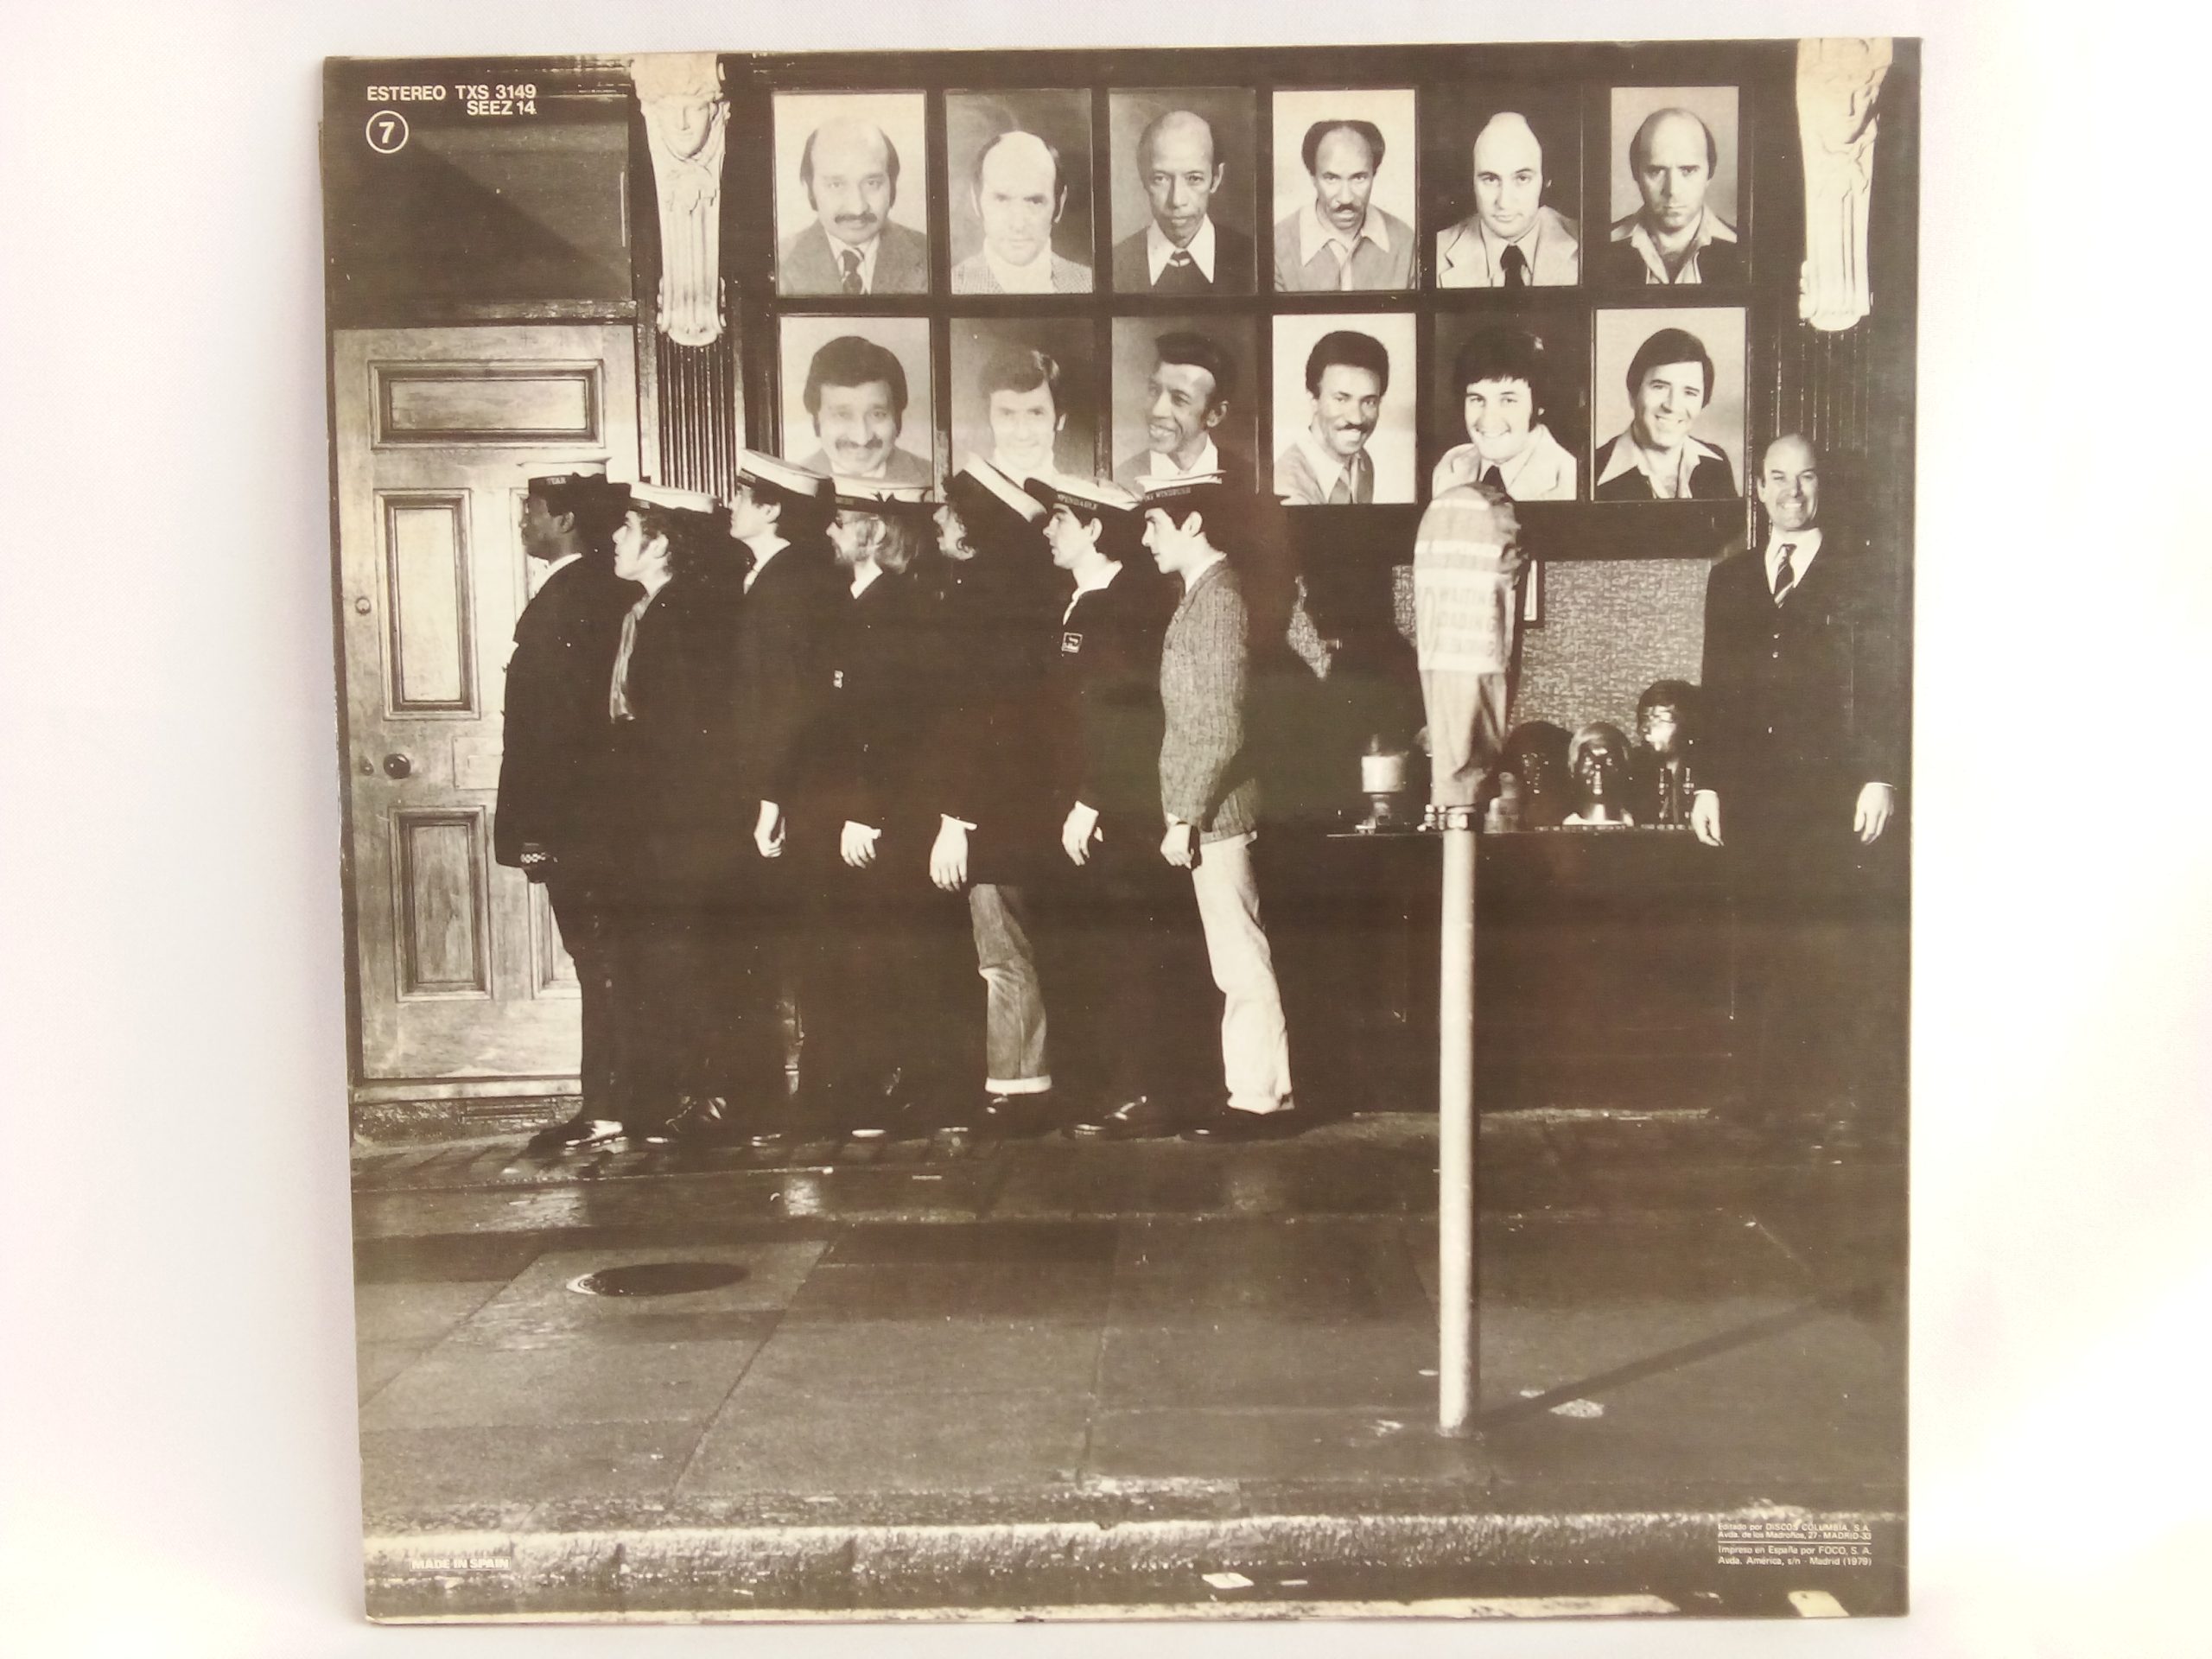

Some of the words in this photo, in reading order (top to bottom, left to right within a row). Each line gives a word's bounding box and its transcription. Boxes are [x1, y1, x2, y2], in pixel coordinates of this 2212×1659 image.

[366, 85, 446, 101] ESTEREO
[454, 85, 490, 100] TXS
[495, 83, 537, 100] 3149
[467, 100, 513, 115] SEEZ
[378, 121, 396, 143] 7
[1718, 1522, 1747, 1531] Editado
[1750, 1524, 1763, 1533] por
[1765, 1523, 1797, 1532] DISCOS
[1718, 1546, 1752, 1555] Impreso
[1768, 1545, 1798, 1555] España
[1801, 1547, 1815, 1556] por
[411, 1558, 450, 1569] MADE
[454, 1558, 468, 1569] IN
[469, 1558, 509, 1569] SPAIN
[1718, 1556, 1743, 1565] Avda.
[1746, 1556, 1785, 1567] América,
[1787, 1557, 1802, 1566] s/n
[1808, 1556, 1840, 1566] Madrid
[1842, 1556, 1872, 1567] (1979)
